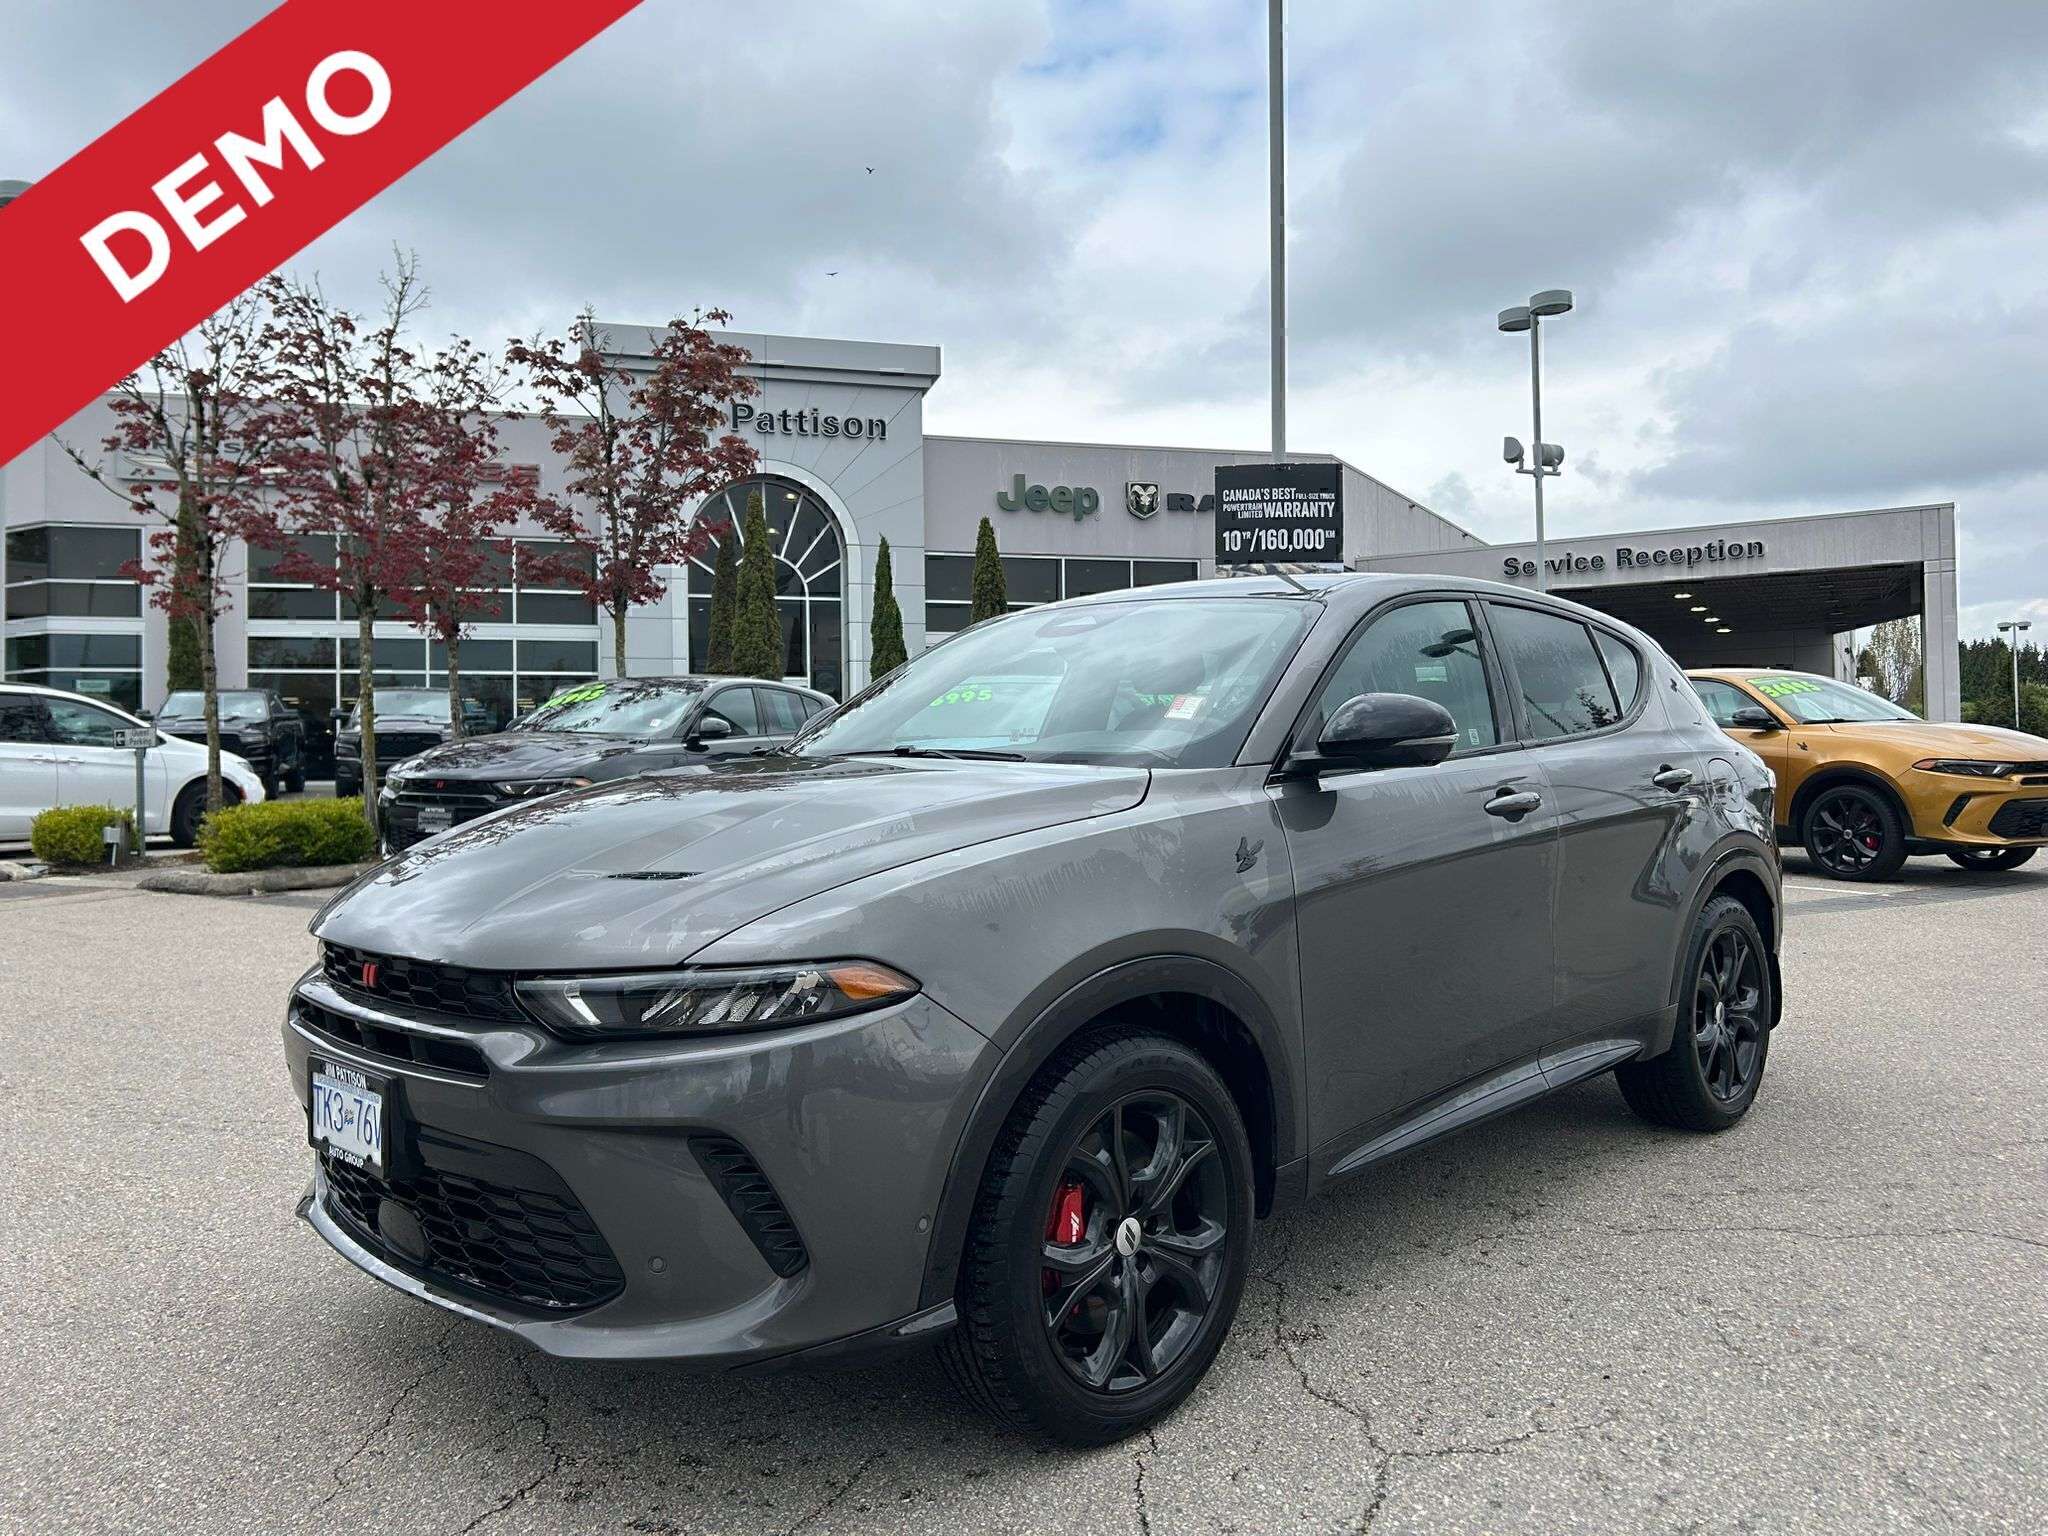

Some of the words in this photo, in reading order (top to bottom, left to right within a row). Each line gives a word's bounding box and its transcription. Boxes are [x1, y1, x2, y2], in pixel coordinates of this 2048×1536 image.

[731, 402, 888, 441] Pattison
[997, 473, 1099, 522] Jeep
[1166, 492, 1215, 512] RA
[1222, 488, 1270, 502] CANADA'S
[1271, 487, 1297, 501] BEST
[1222, 502, 1263, 513] POWERTRAIN
[1263, 501, 1336, 519] WARRANTY
[1237, 510, 1263, 519] LIMITED
[1615, 538, 1766, 569] Reception
[336, 1066, 367, 1090] PATTISON
[312, 1084, 344, 1132] TK3
[328, 1145, 344, 1160] AUTO
[344, 1151, 364, 1169] GROUP
